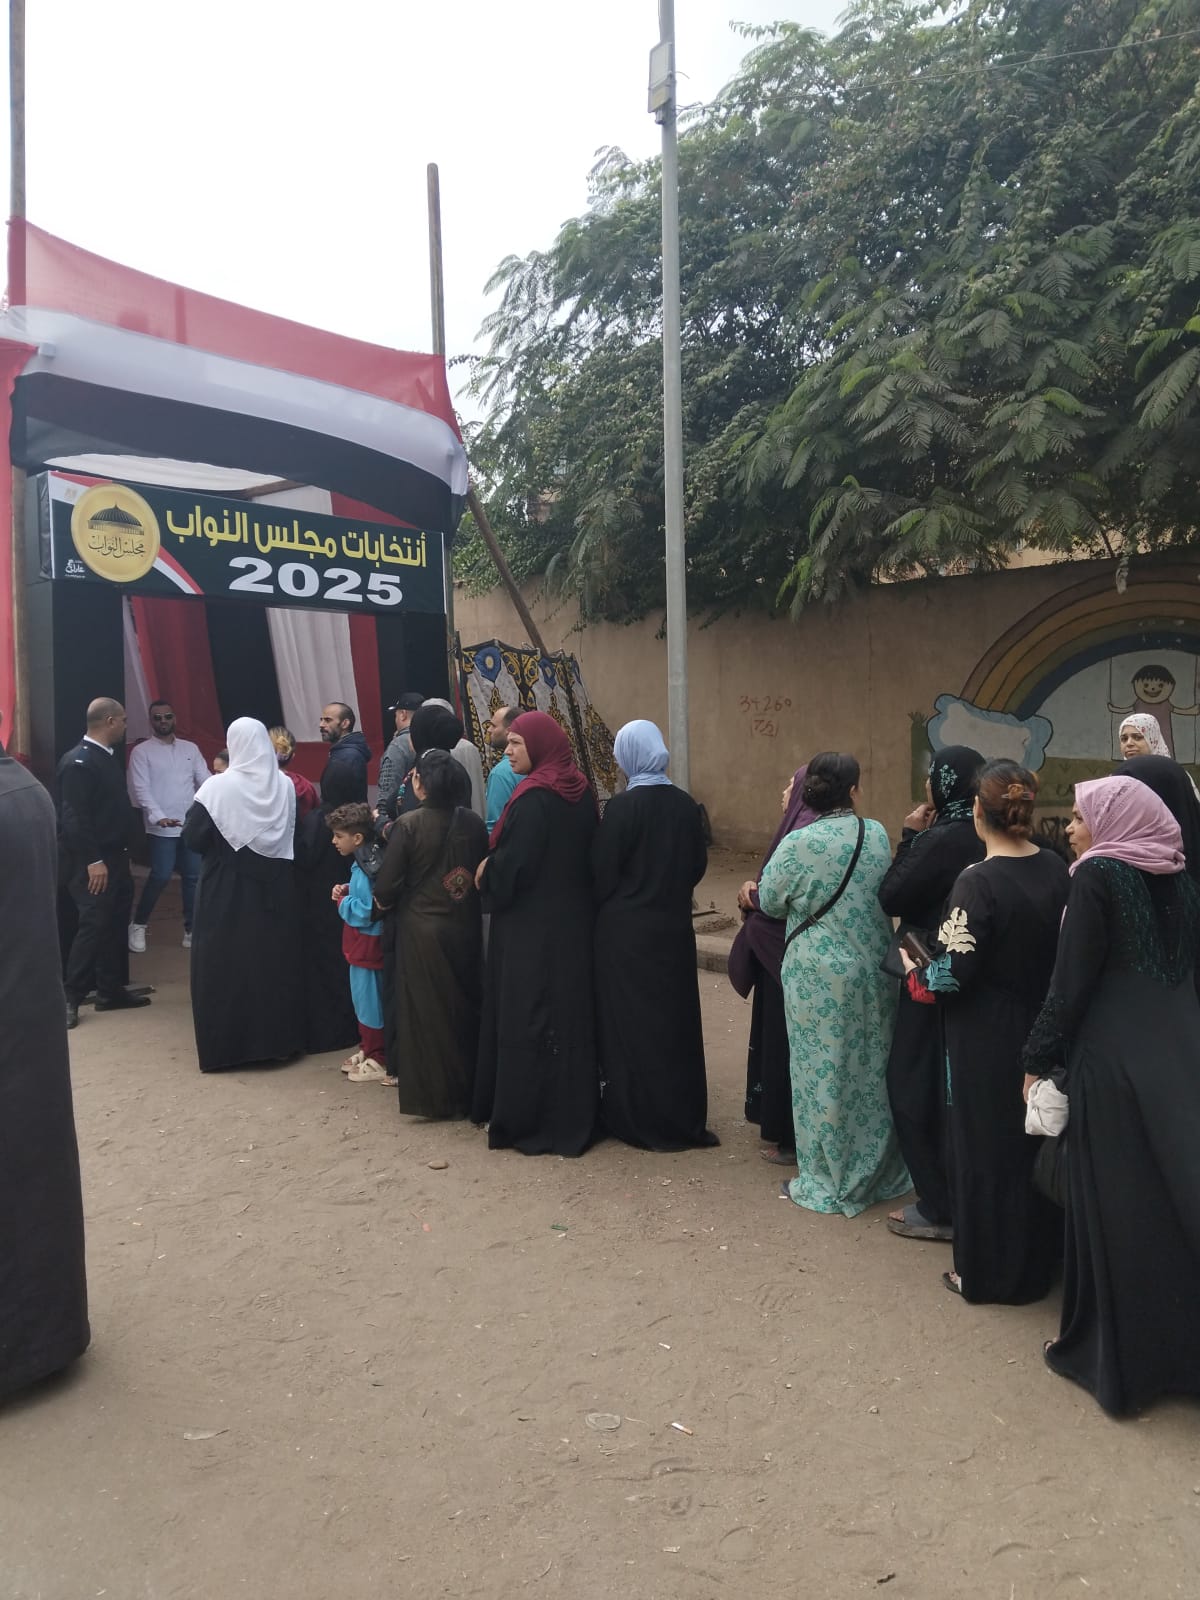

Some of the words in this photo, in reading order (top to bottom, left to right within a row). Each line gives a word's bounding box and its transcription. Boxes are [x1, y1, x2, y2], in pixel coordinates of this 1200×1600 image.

[88, 535, 122, 557] النواب
[165, 505, 249, 546] النواب
[253, 520, 338, 561] مجلس
[113, 538, 146, 559] مجلس
[228, 556, 403, 606] 2025
